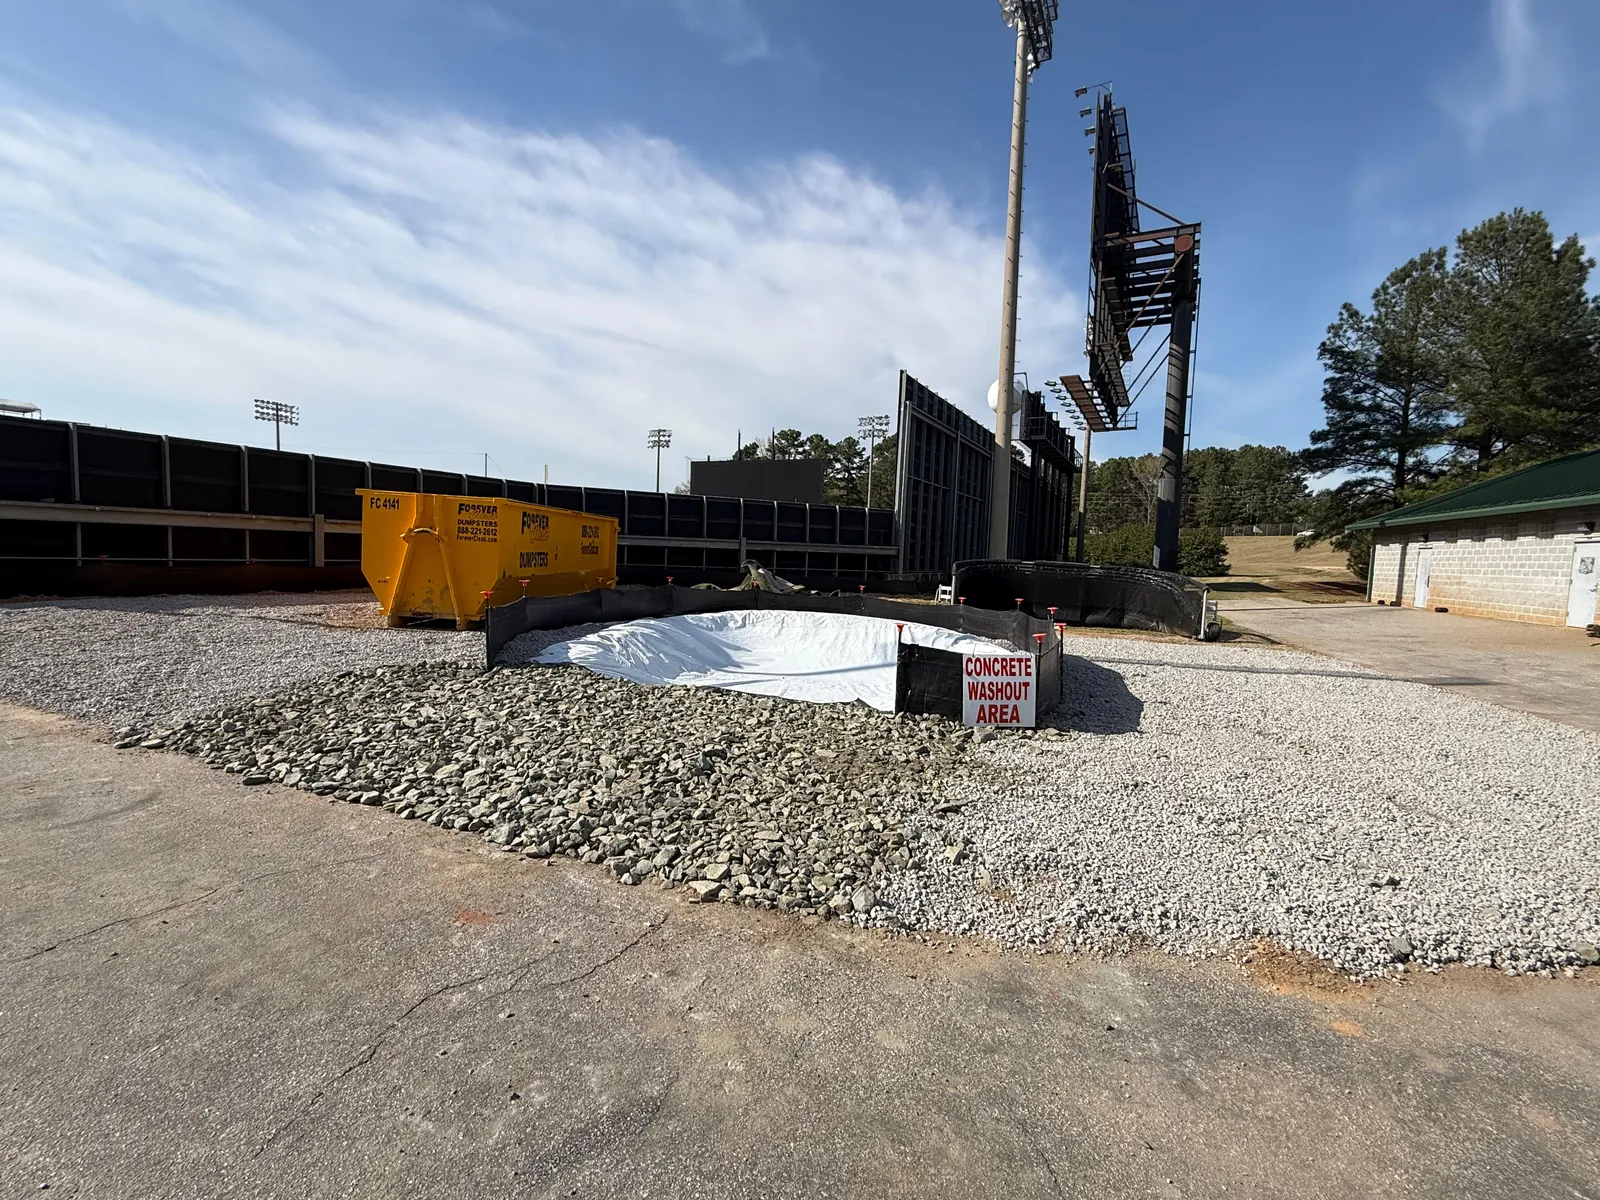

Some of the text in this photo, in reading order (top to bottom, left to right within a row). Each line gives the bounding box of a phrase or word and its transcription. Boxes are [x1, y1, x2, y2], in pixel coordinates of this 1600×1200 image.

[370, 497, 400, 510] FC 4141
[458, 503, 498, 515] FOREVER
[457, 519, 498, 528] DUMPSTERS
[457, 526, 498, 537] 888-221-2612
[519, 551, 549, 568] DUMPSTERS
[965, 657, 1032, 677] CONCRETE
[967, 681, 1030, 701] WASHOUT
[976, 704, 1021, 724] AREA
